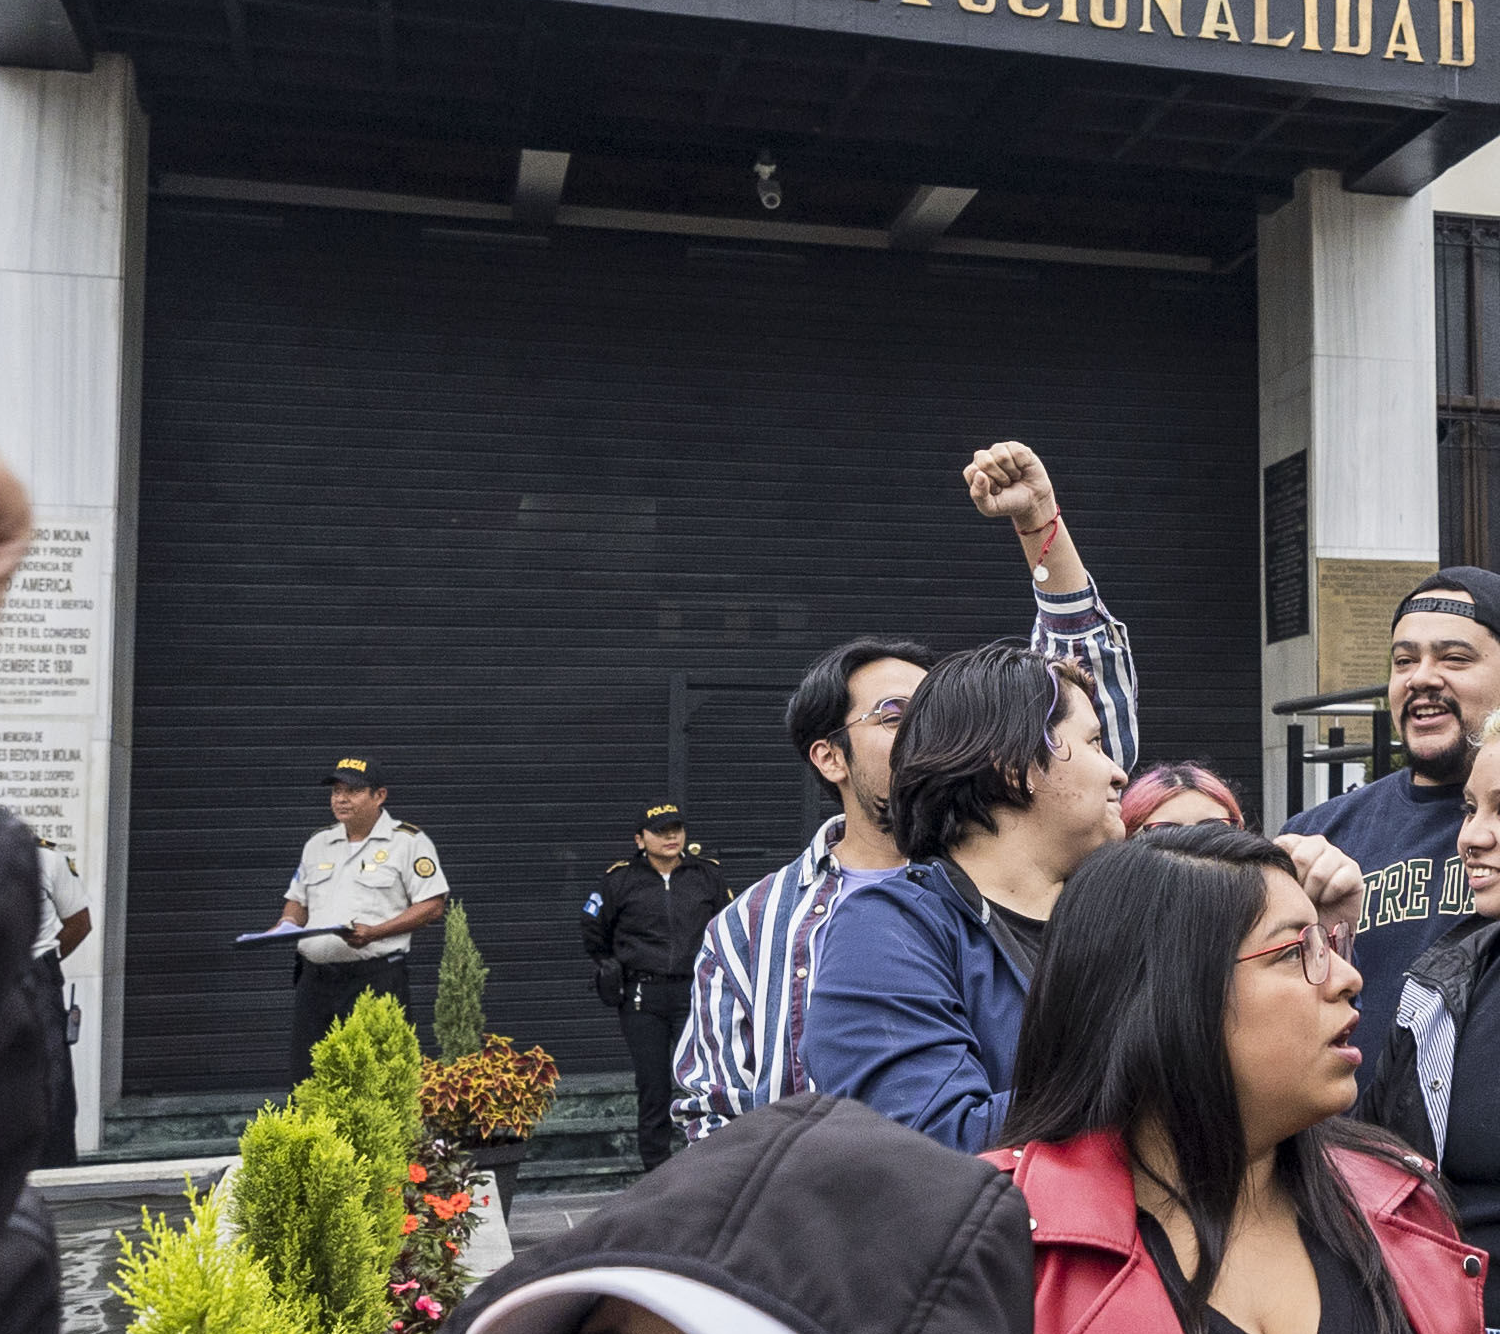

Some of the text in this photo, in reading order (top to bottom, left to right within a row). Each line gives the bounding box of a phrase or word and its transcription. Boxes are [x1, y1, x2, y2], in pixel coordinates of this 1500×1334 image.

[30, 528, 91, 542] DRO MOLINA
[18, 561, 59, 573] ENDENCIA
[21, 578, 73, 593] AMERICA
[39, 659, 51, 673] DE
[1356, 857, 1434, 934] TRE
